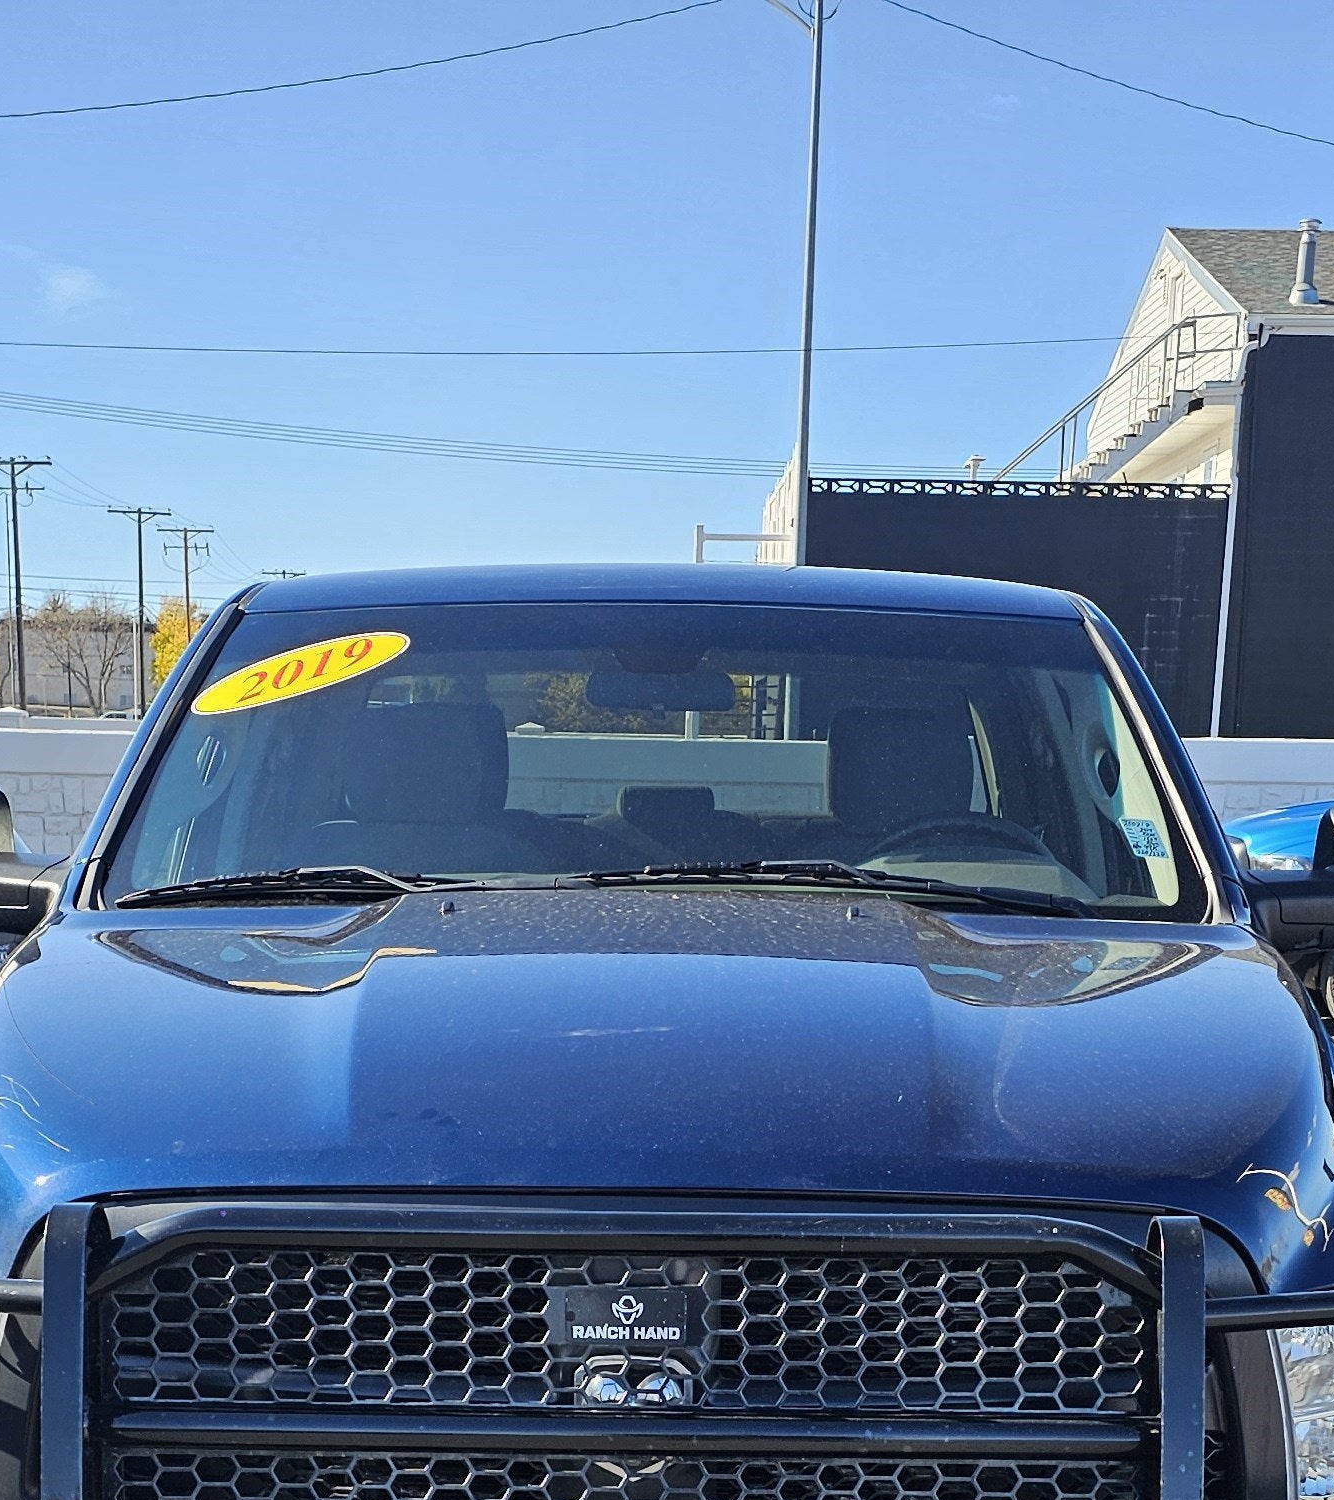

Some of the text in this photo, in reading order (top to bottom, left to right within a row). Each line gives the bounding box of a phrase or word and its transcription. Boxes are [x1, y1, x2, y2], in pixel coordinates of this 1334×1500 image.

[236, 638, 373, 704] 2019
[572, 1325, 681, 1340] RANCH HAND
